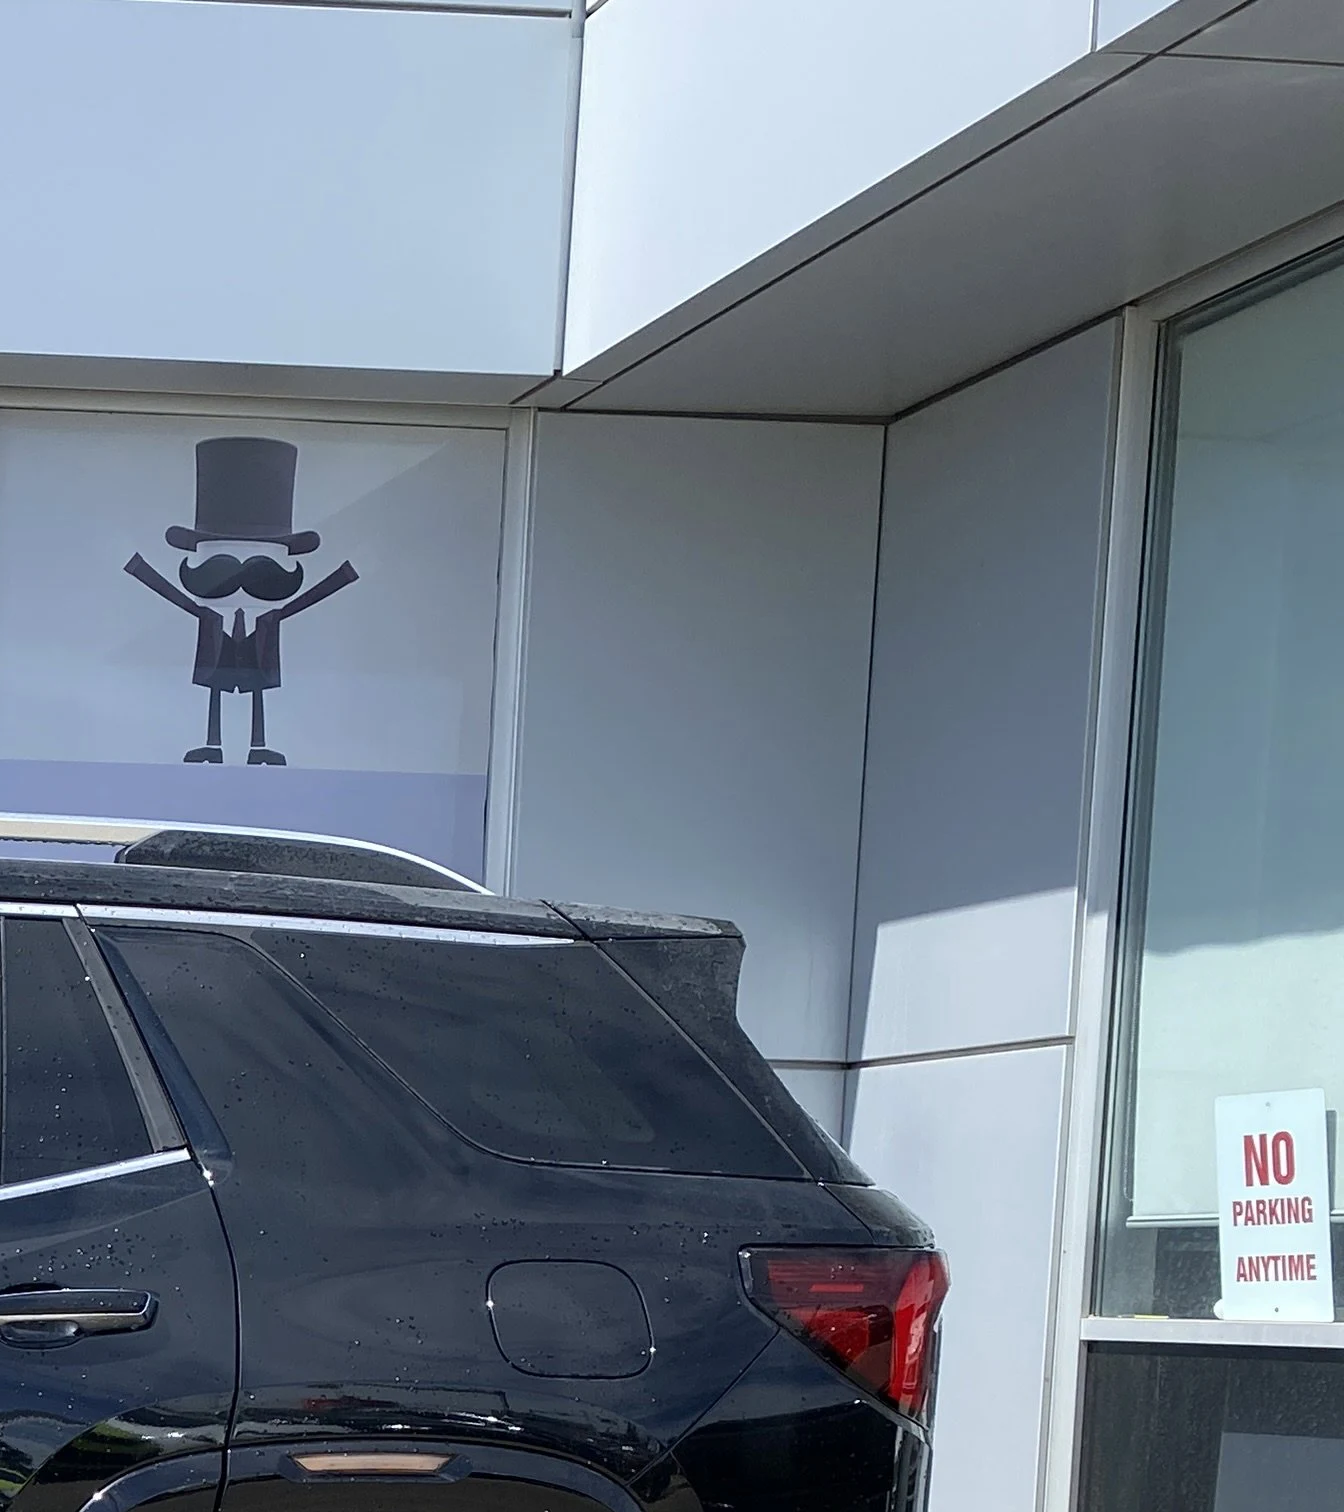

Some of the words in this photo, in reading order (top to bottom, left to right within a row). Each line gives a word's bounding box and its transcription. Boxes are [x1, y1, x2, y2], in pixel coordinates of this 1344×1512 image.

[1243, 1130, 1296, 1188] NO
[1232, 1196, 1314, 1227] PARKING
[1235, 1253, 1318, 1283] ANYTIME
